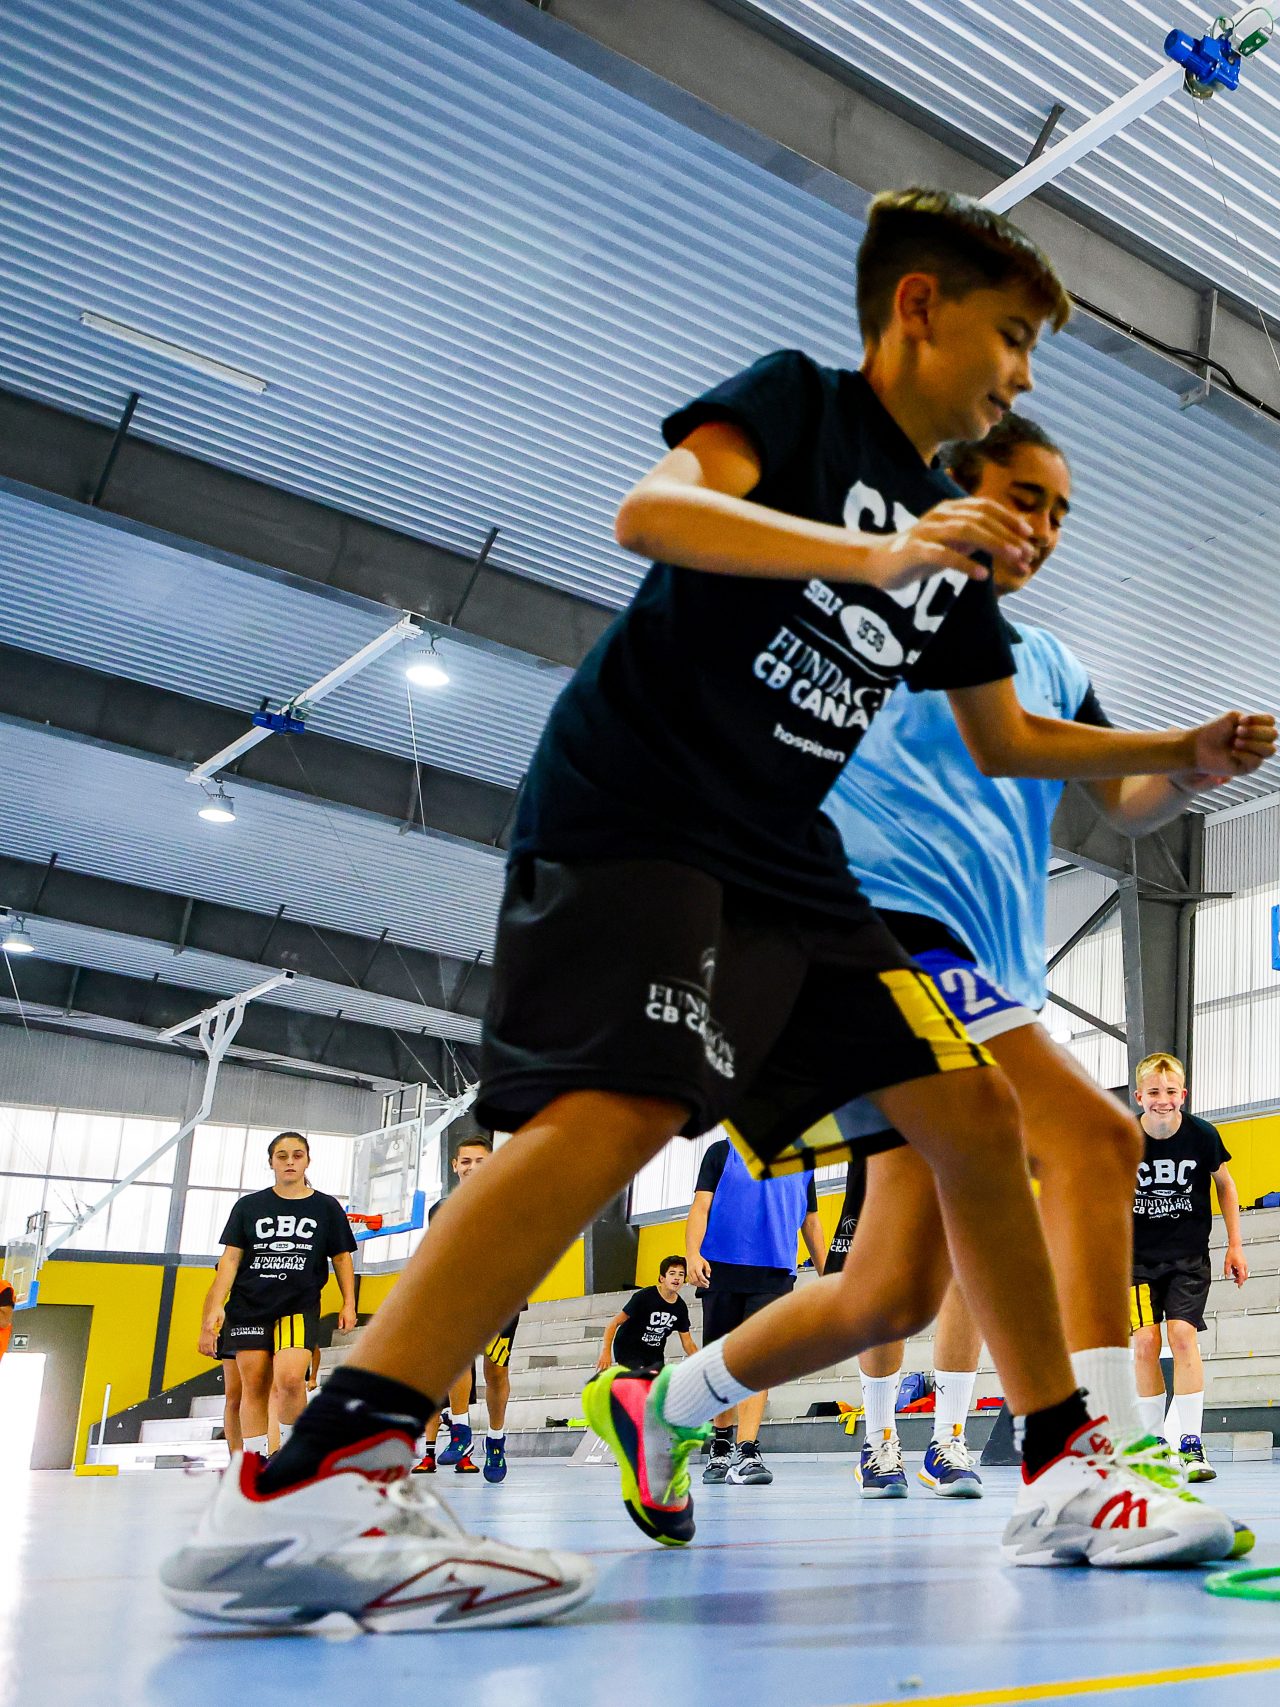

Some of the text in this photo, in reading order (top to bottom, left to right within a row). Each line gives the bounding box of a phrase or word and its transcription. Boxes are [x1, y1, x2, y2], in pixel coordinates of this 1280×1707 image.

[843, 480, 969, 633] CC
[803, 578, 844, 616] SELF
[753, 652, 793, 690] CB
[773, 722, 846, 764] hospiten
[645, 1002, 679, 1023] CB
[1136, 1159, 1197, 1187] CBC
[1132, 1205, 1145, 1215] CB
[1148, 1201, 1193, 1216] CANARIAS
[255, 1215, 318, 1239] CBC
[262, 1262, 305, 1271] CANARIAS
[650, 1311, 678, 1327] CBC
